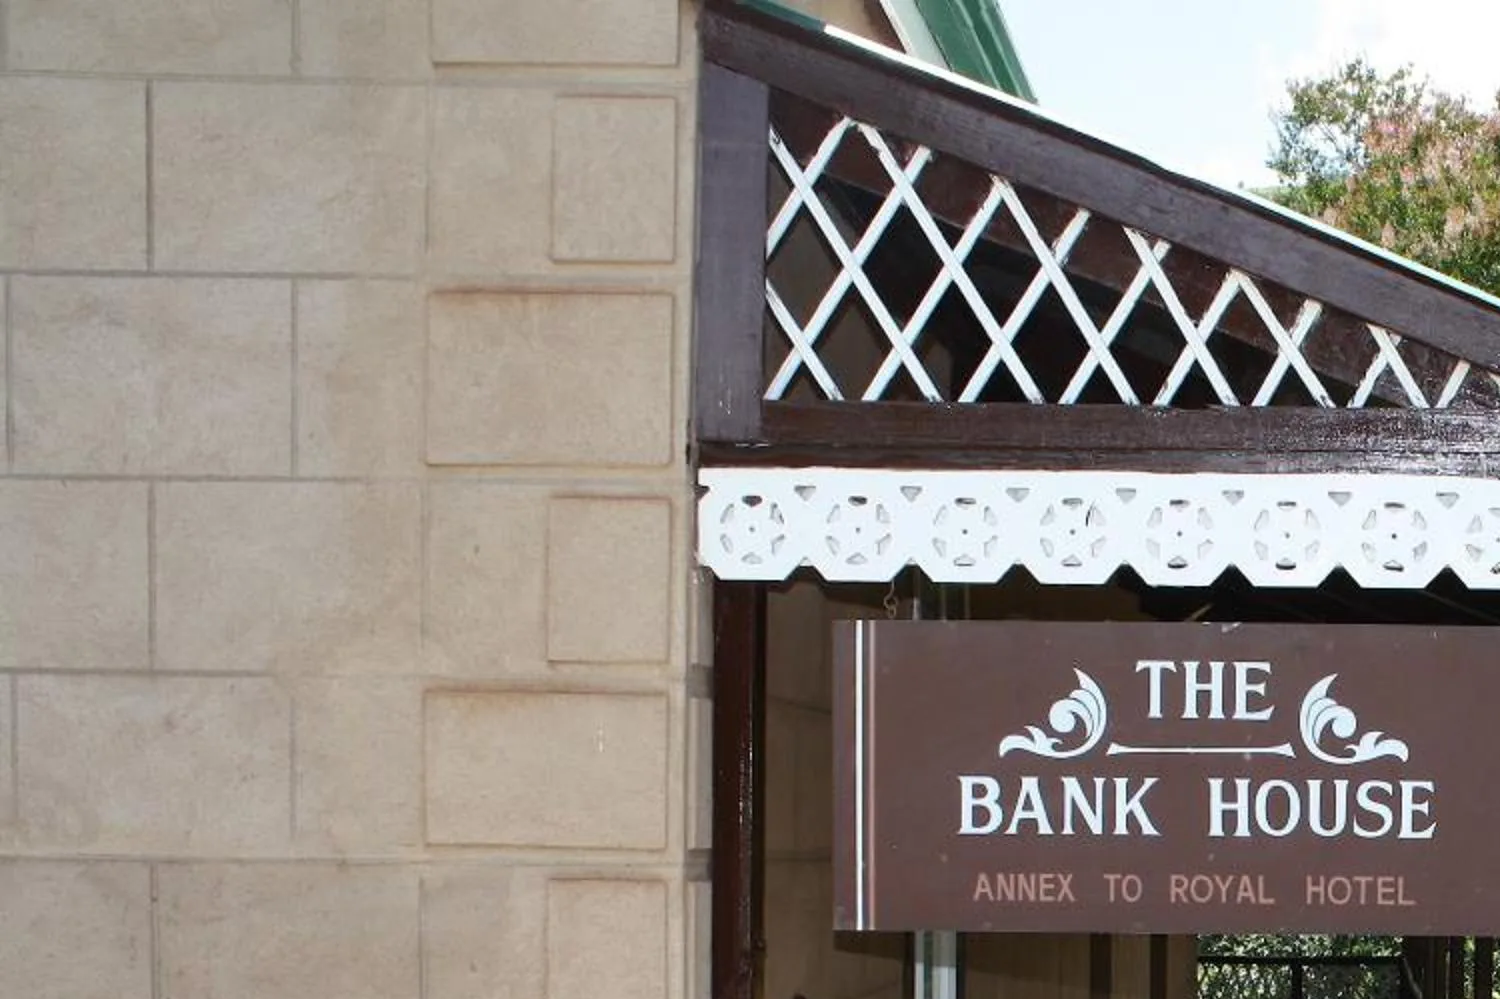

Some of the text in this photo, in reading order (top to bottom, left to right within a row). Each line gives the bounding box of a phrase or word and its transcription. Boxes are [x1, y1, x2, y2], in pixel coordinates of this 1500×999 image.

[1135, 659, 1275, 721] THE
[957, 775, 1437, 839] BANK HOUSE
[973, 872, 1416, 906] ANNEX TO ROYAL HOTEL
